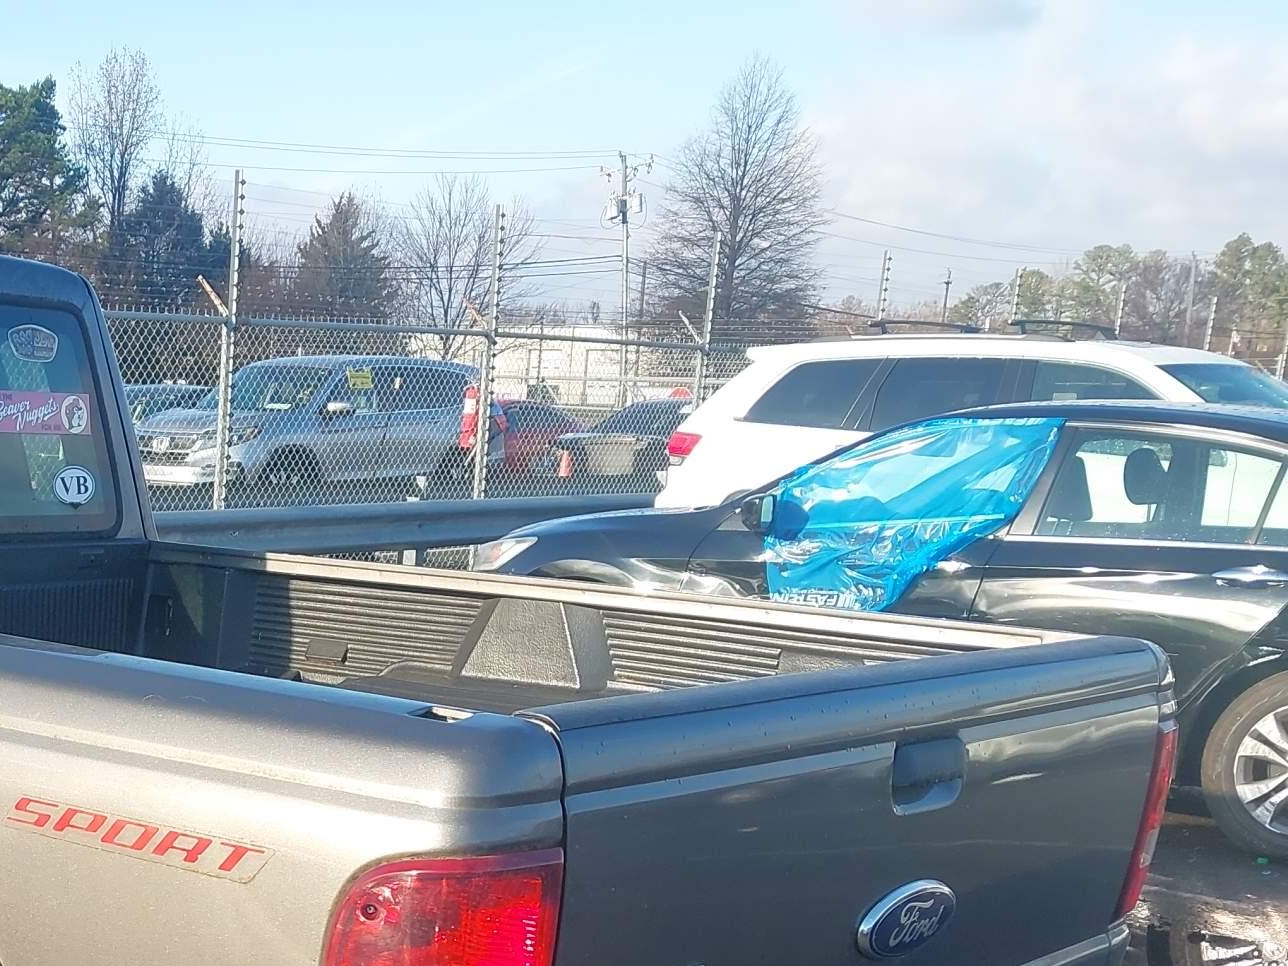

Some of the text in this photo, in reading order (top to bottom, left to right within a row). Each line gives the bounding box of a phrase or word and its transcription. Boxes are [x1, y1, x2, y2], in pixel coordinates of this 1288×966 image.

[12, 397, 59, 431] Nuggets
[59, 475, 89, 496] VB
[6, 797, 265, 872] SPORT
[889, 898, 944, 947] Ford
